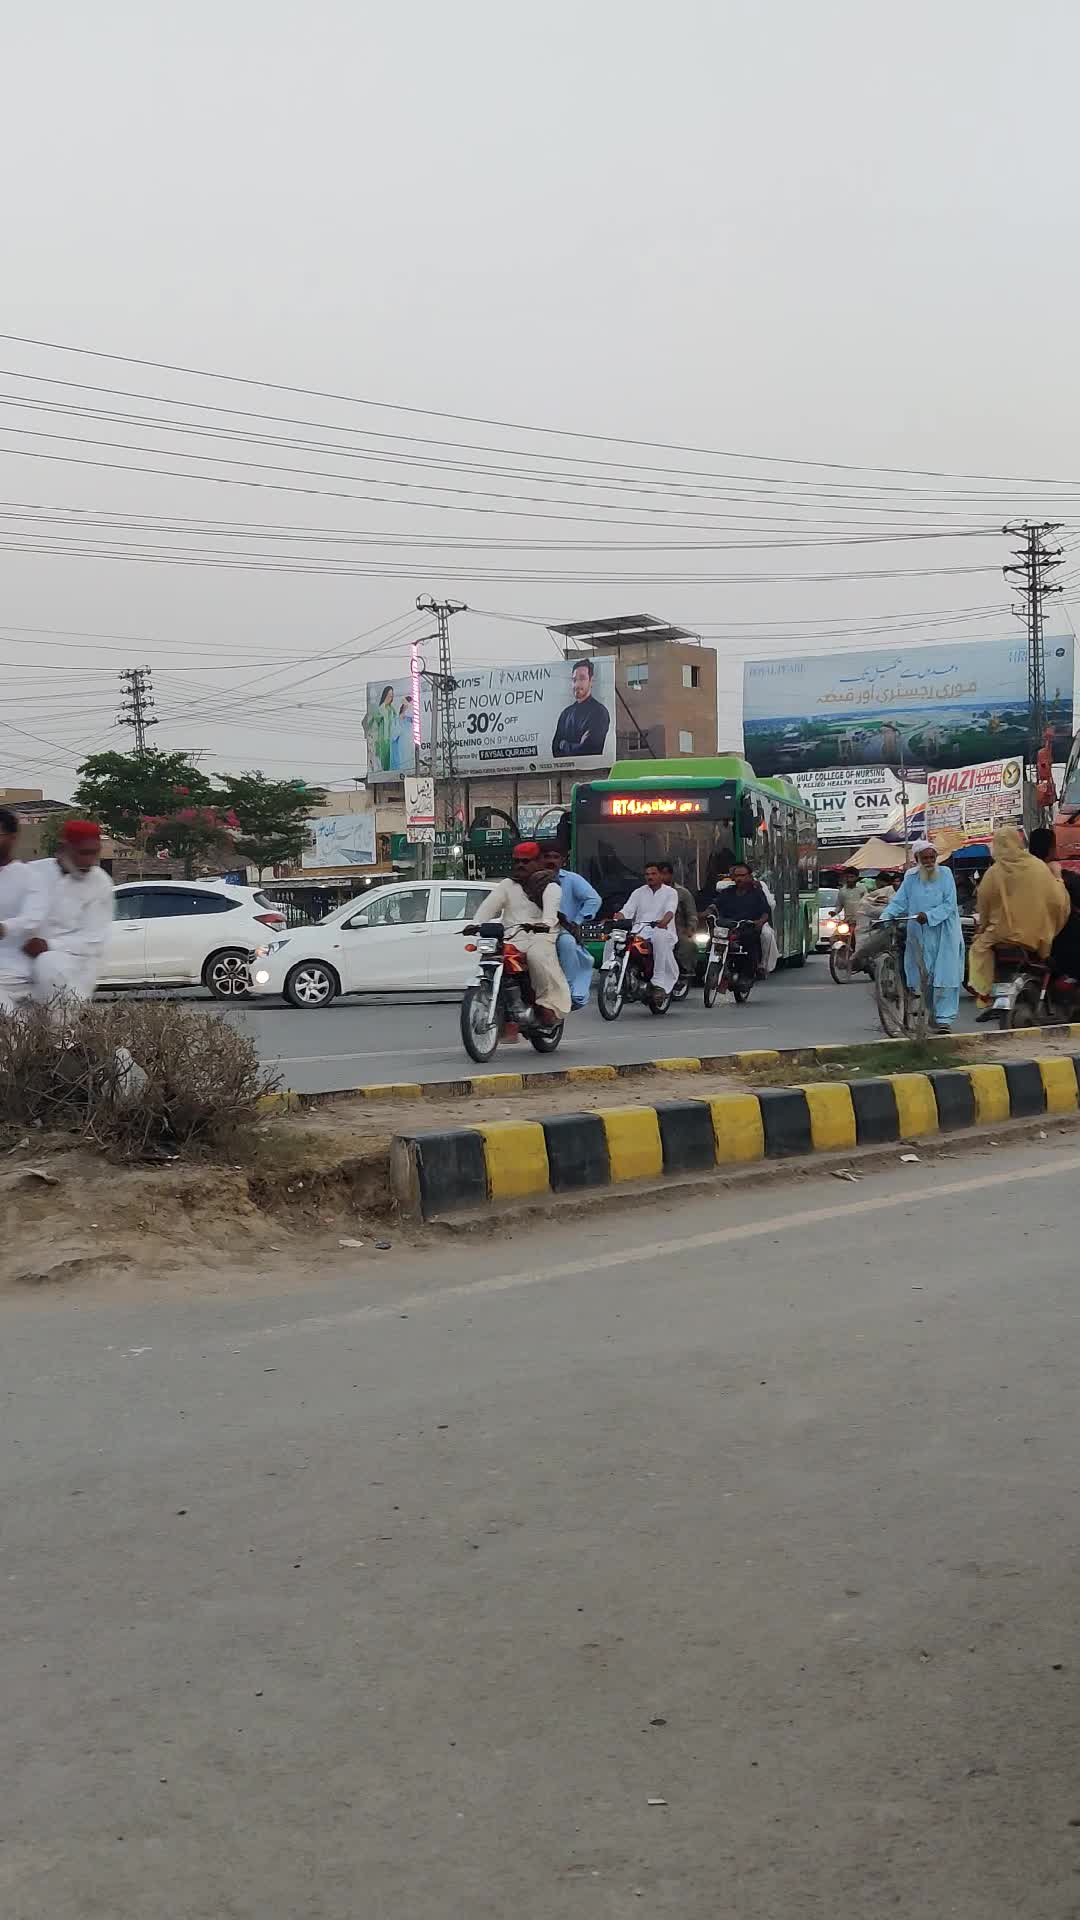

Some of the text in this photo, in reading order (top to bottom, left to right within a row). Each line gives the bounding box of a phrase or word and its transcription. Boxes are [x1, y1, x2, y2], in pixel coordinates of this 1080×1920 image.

[506, 668, 552, 683] NARMIN
[469, 693, 502, 709] NOW
[504, 688, 544, 705] OPEN
[466, 712, 505, 734] 30%
[504, 716, 519, 725] OFF
[483, 736, 496, 745] ON
[508, 732, 540, 744] AUGUST
[480, 750, 505, 760] FAYSAL
[505, 746, 537, 758] QURAISHI
[796, 768, 885, 782] GULF COLLEGE OF NURSING
[976, 765, 1002, 777] FUTURE
[827, 779, 852, 787] HEALTH
[927, 769, 976, 797] GHAZI
[975, 774, 1001, 786] LEADS
[854, 794, 891, 808] CNA
